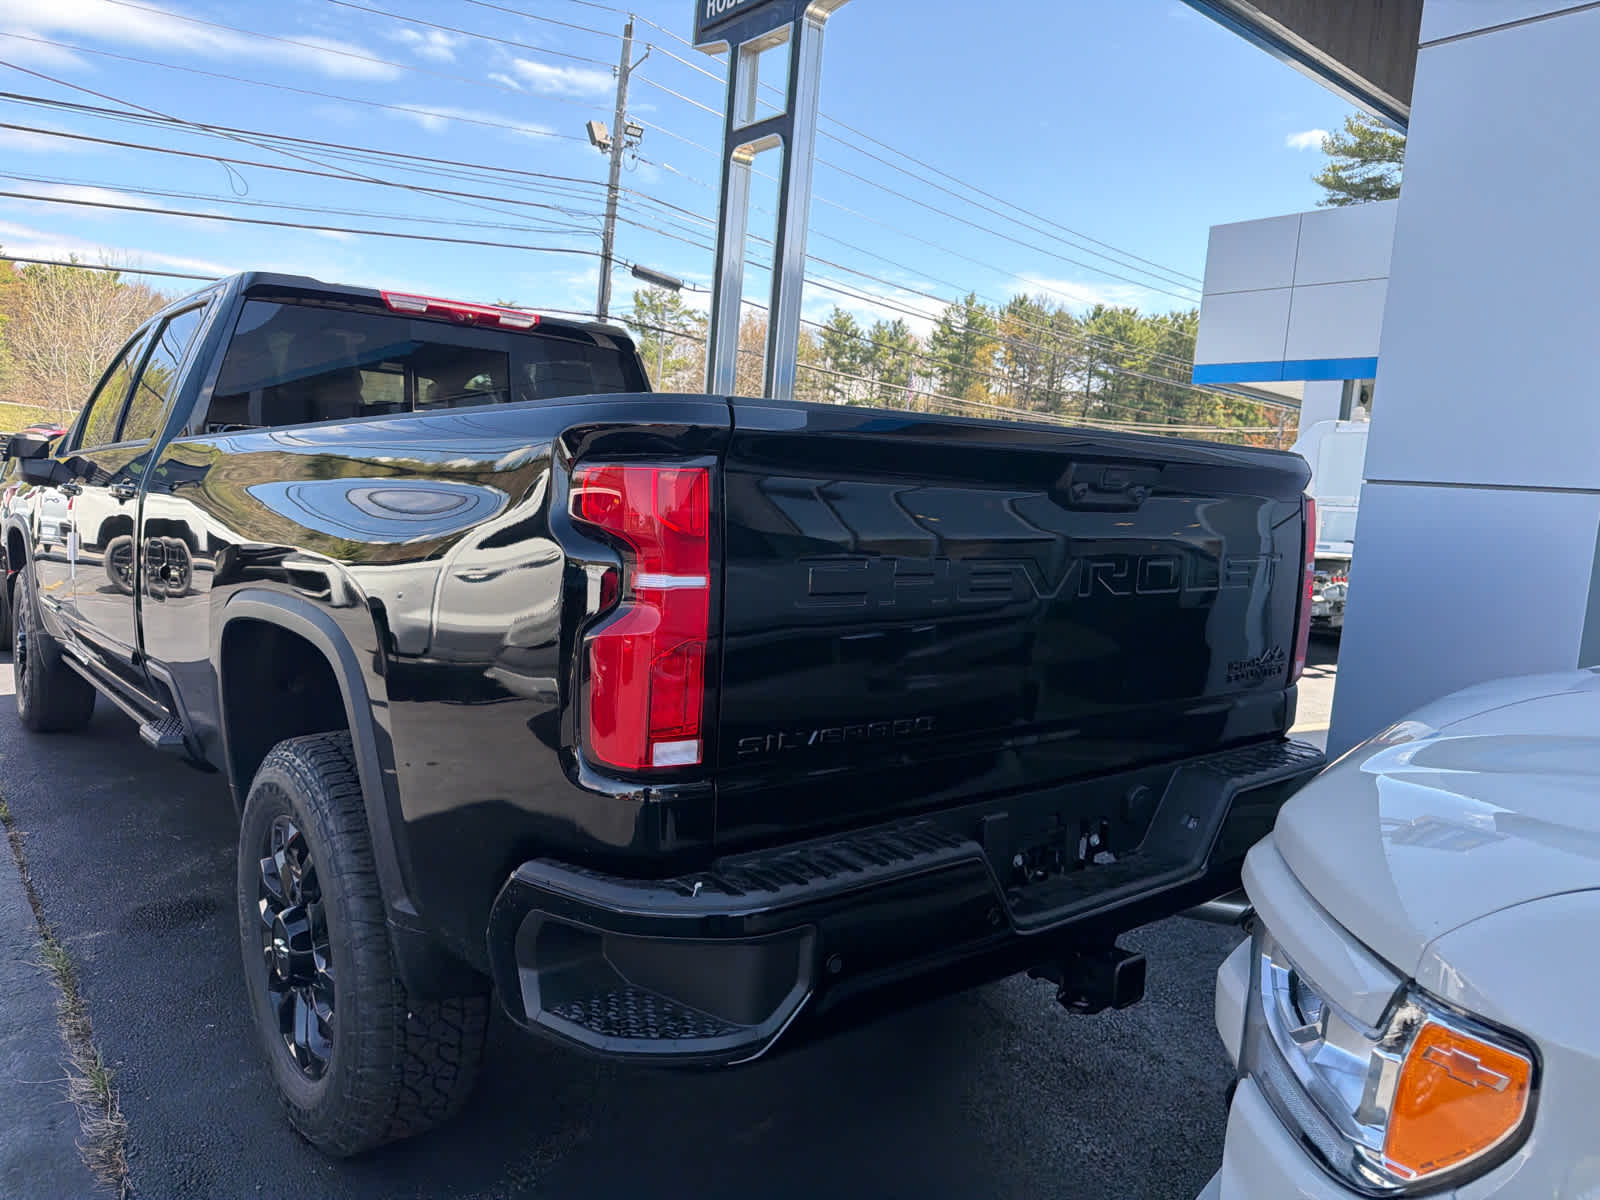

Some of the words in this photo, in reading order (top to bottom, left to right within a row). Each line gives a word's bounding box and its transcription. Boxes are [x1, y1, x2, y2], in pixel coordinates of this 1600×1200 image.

[706, 0, 745, 19] RO
[794, 550, 1283, 608] CHEVROLET
[736, 714, 935, 758] SILVERADO
